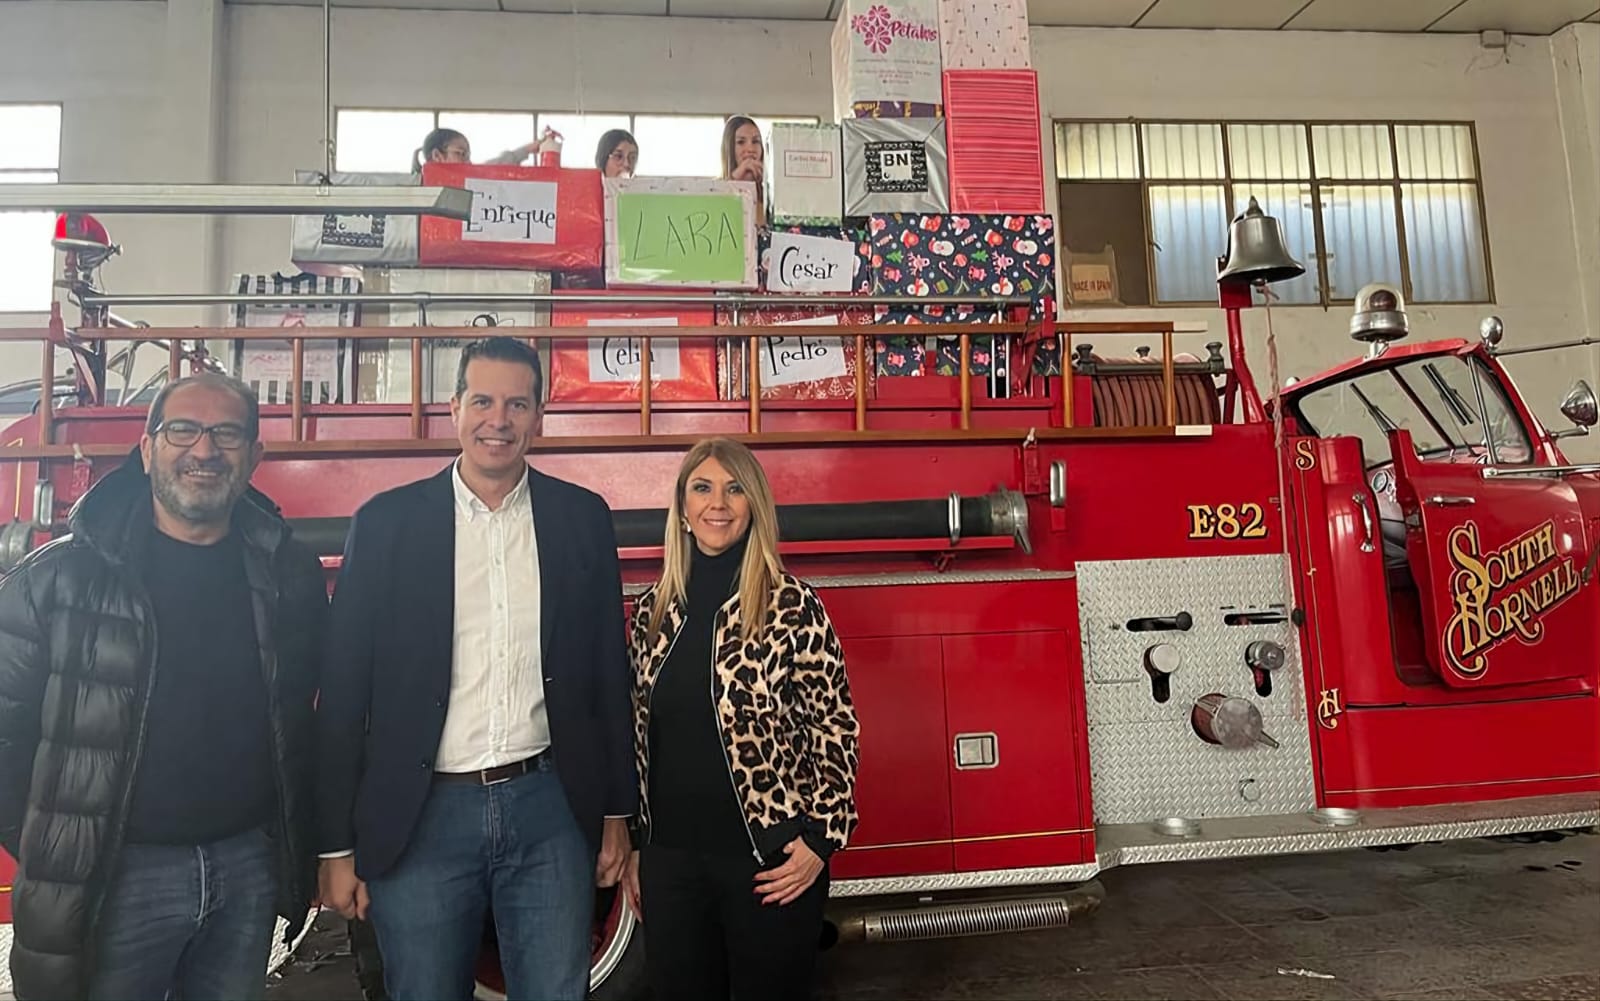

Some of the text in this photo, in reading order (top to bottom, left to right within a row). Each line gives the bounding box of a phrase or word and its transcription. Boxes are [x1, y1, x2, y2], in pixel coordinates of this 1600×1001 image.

[883, 152, 909, 167] BN
[632, 210, 738, 262] LARA
[602, 337, 655, 377] Celi
[766, 336, 828, 377] Pedro
[1295, 439, 1315, 471] S
[1450, 523, 1556, 606] SOUTH
[1447, 559, 1579, 673] HORNELL
[1317, 687, 1343, 730] H
